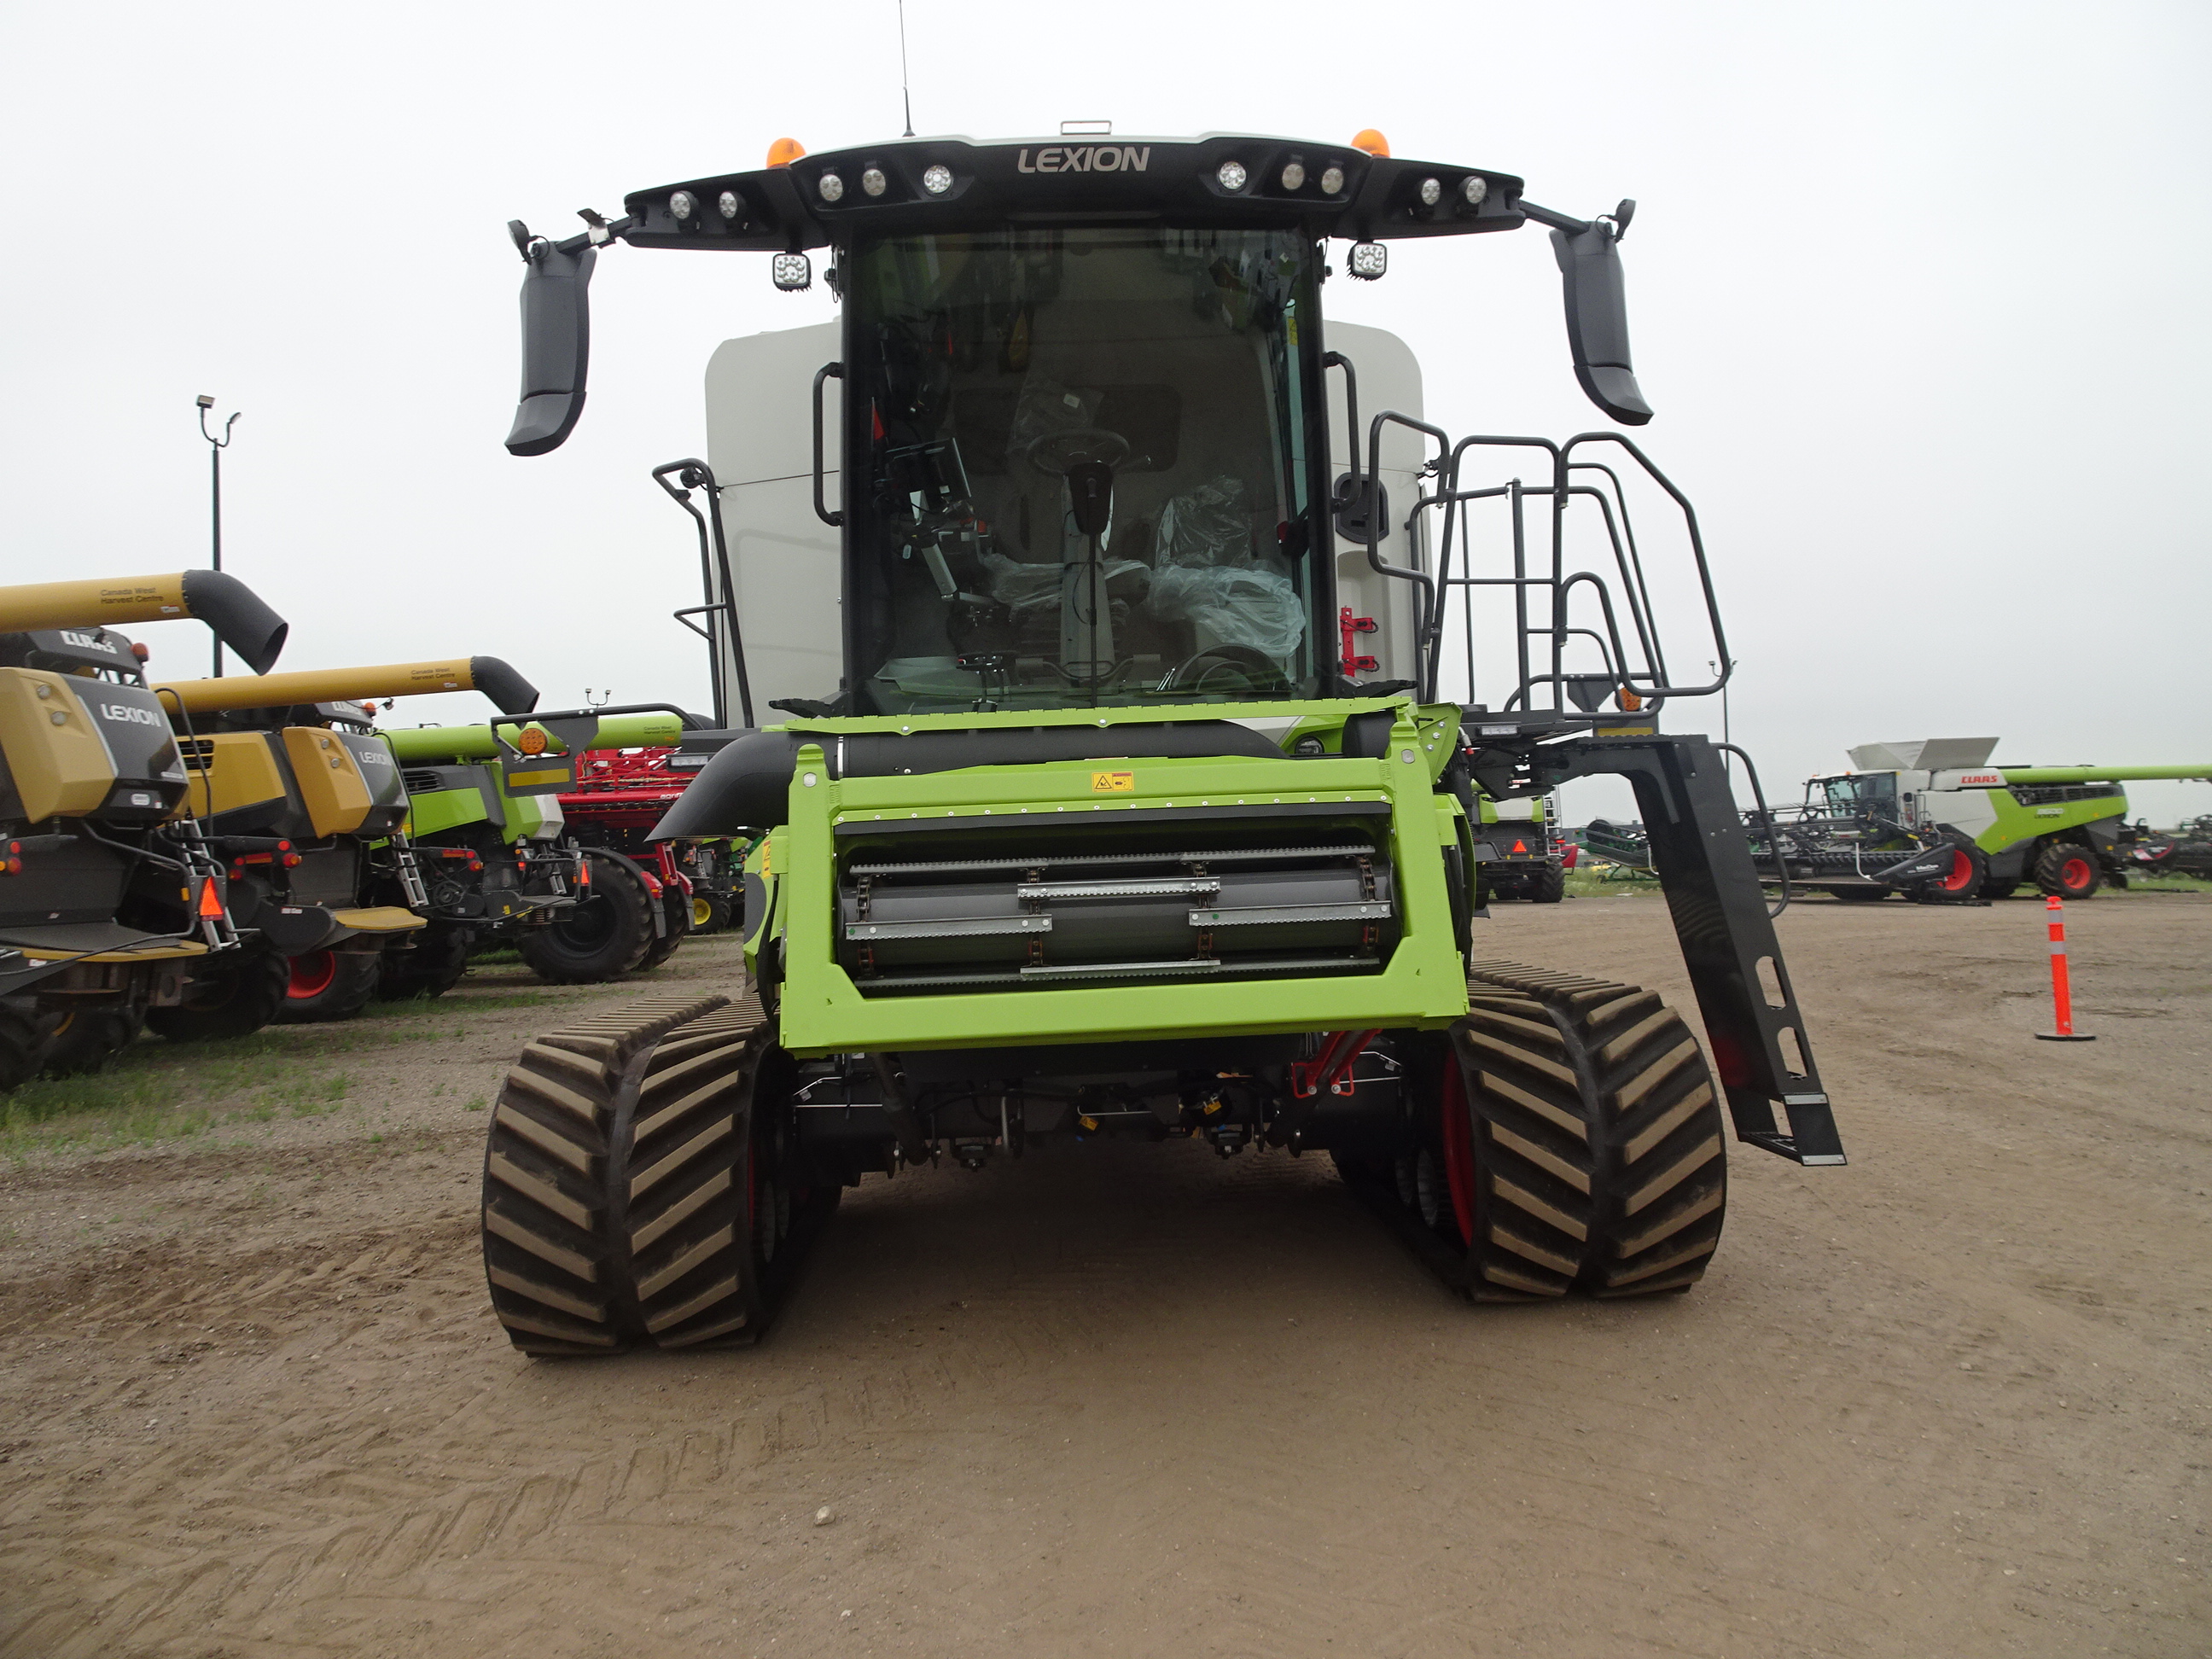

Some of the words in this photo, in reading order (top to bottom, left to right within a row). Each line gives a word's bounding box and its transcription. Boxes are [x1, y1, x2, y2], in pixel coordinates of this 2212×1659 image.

[1018, 147, 1150, 173] LEXION
[101, 703, 161, 727] LEXION
[359, 751, 392, 766] LEXION
[1961, 775, 1998, 783] CLAAS
